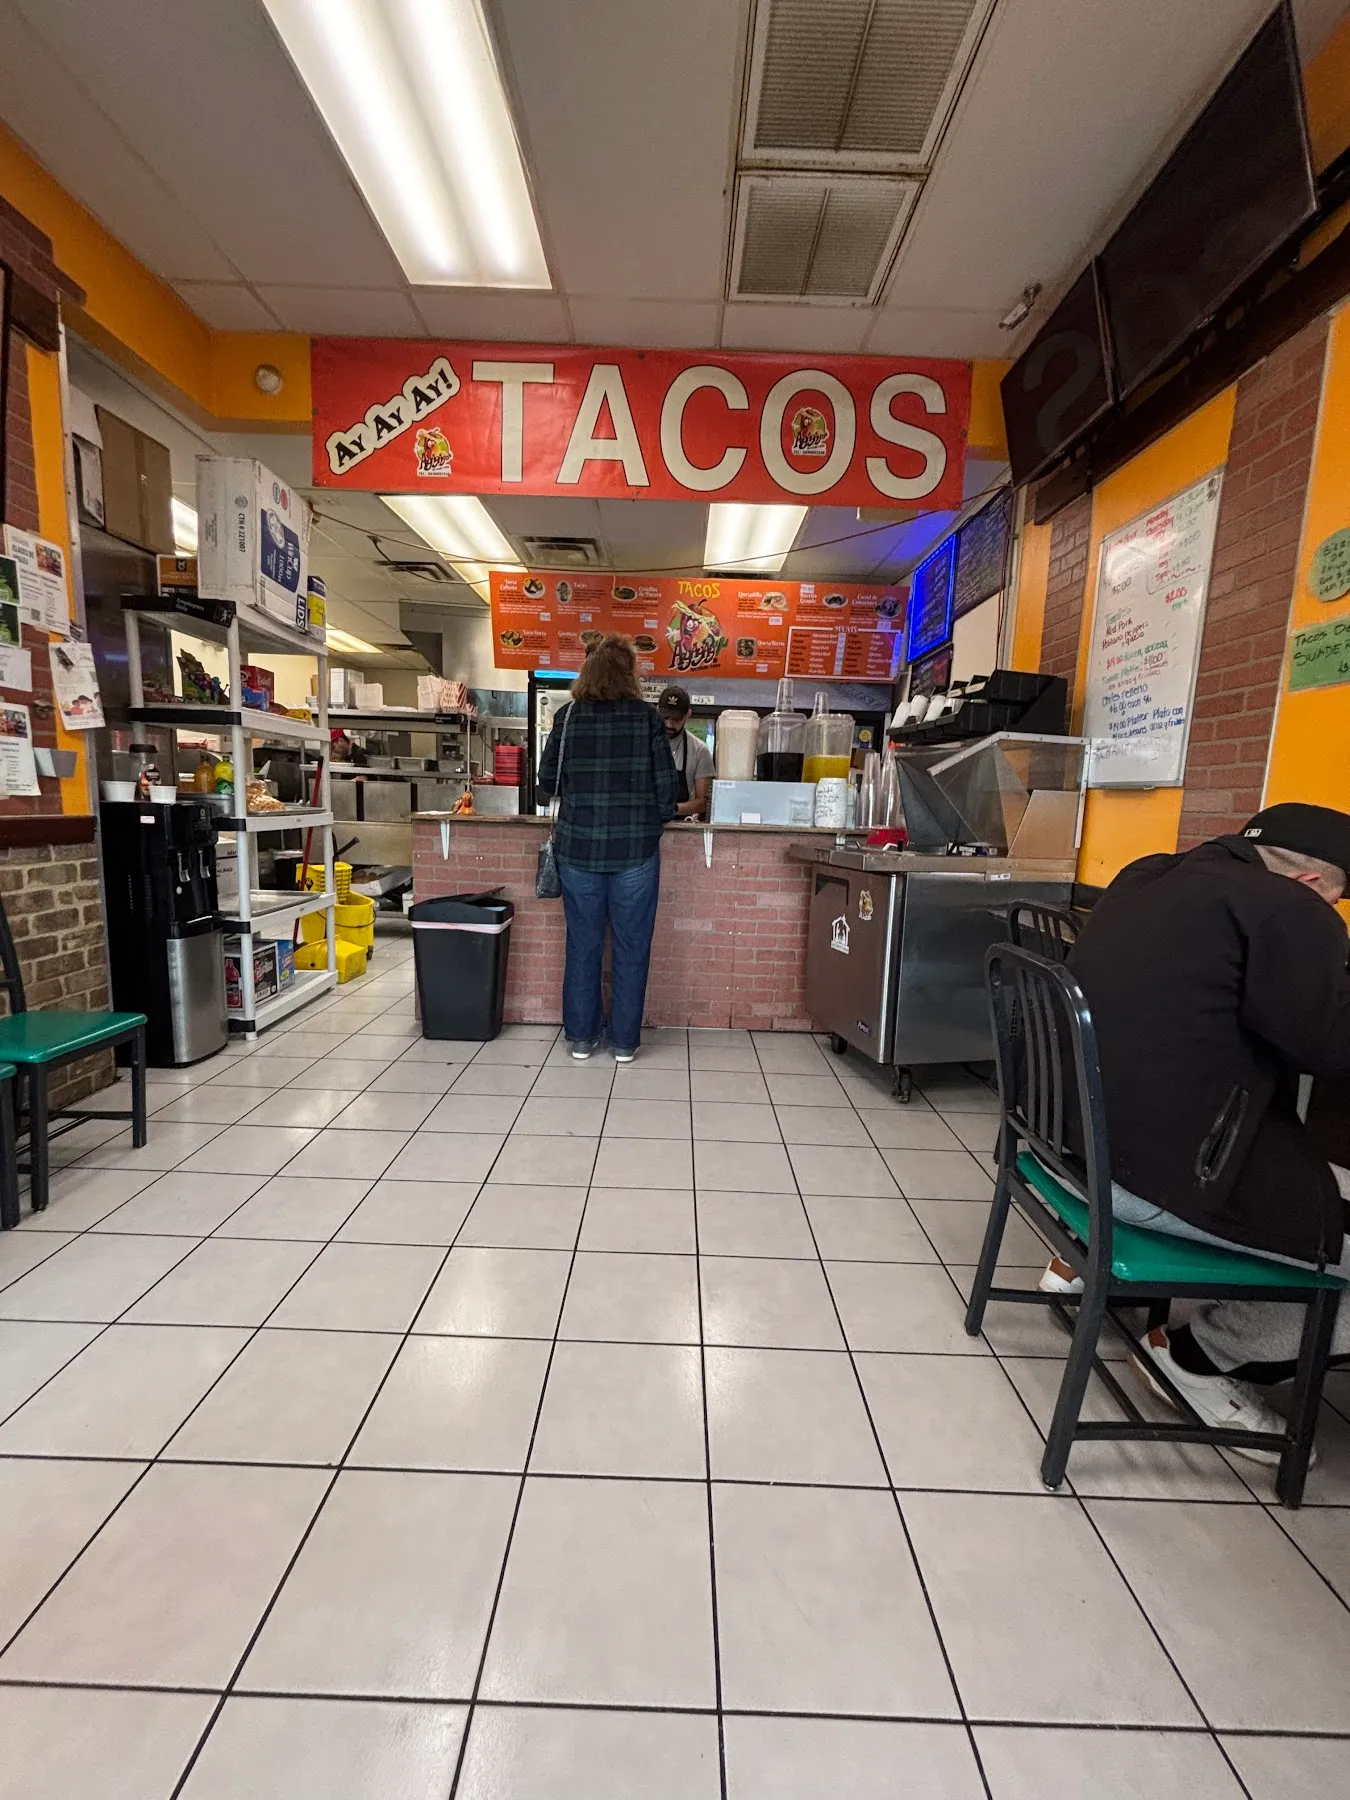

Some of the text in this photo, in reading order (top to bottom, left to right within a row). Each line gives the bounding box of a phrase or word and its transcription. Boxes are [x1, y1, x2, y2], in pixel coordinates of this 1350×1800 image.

[335, 368, 453, 468] AY AY AY!
[471, 360, 948, 500] TACOS
[285, 541, 295, 580] WinCup
[678, 581, 720, 599] TACOS
[297, 598, 306, 628] LIDS
